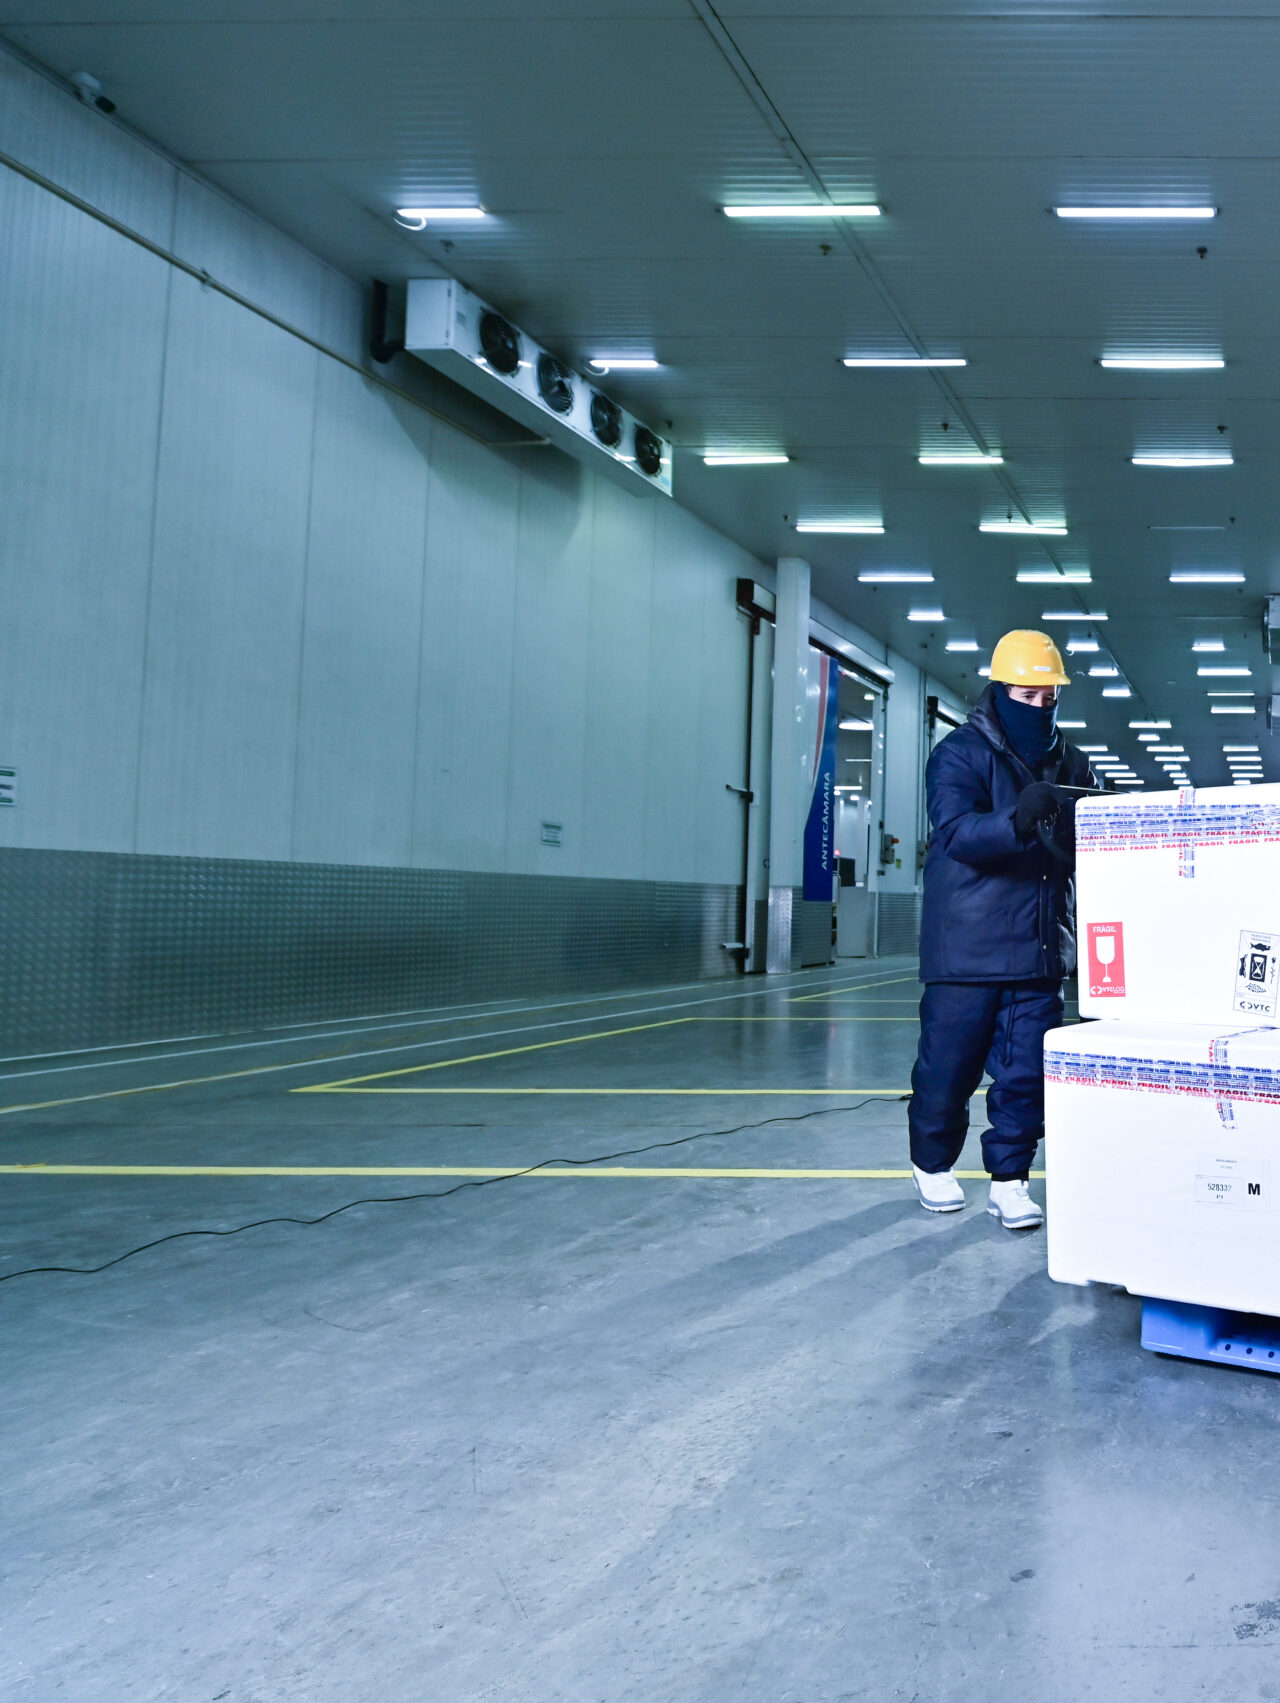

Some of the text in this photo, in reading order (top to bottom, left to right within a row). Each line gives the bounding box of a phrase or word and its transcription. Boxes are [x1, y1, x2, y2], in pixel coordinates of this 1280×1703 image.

[821, 771, 830, 871] ANTECÂMARA
[1093, 925, 1117, 933] FRÁGIL
[1247, 1182, 1261, 1196] M
